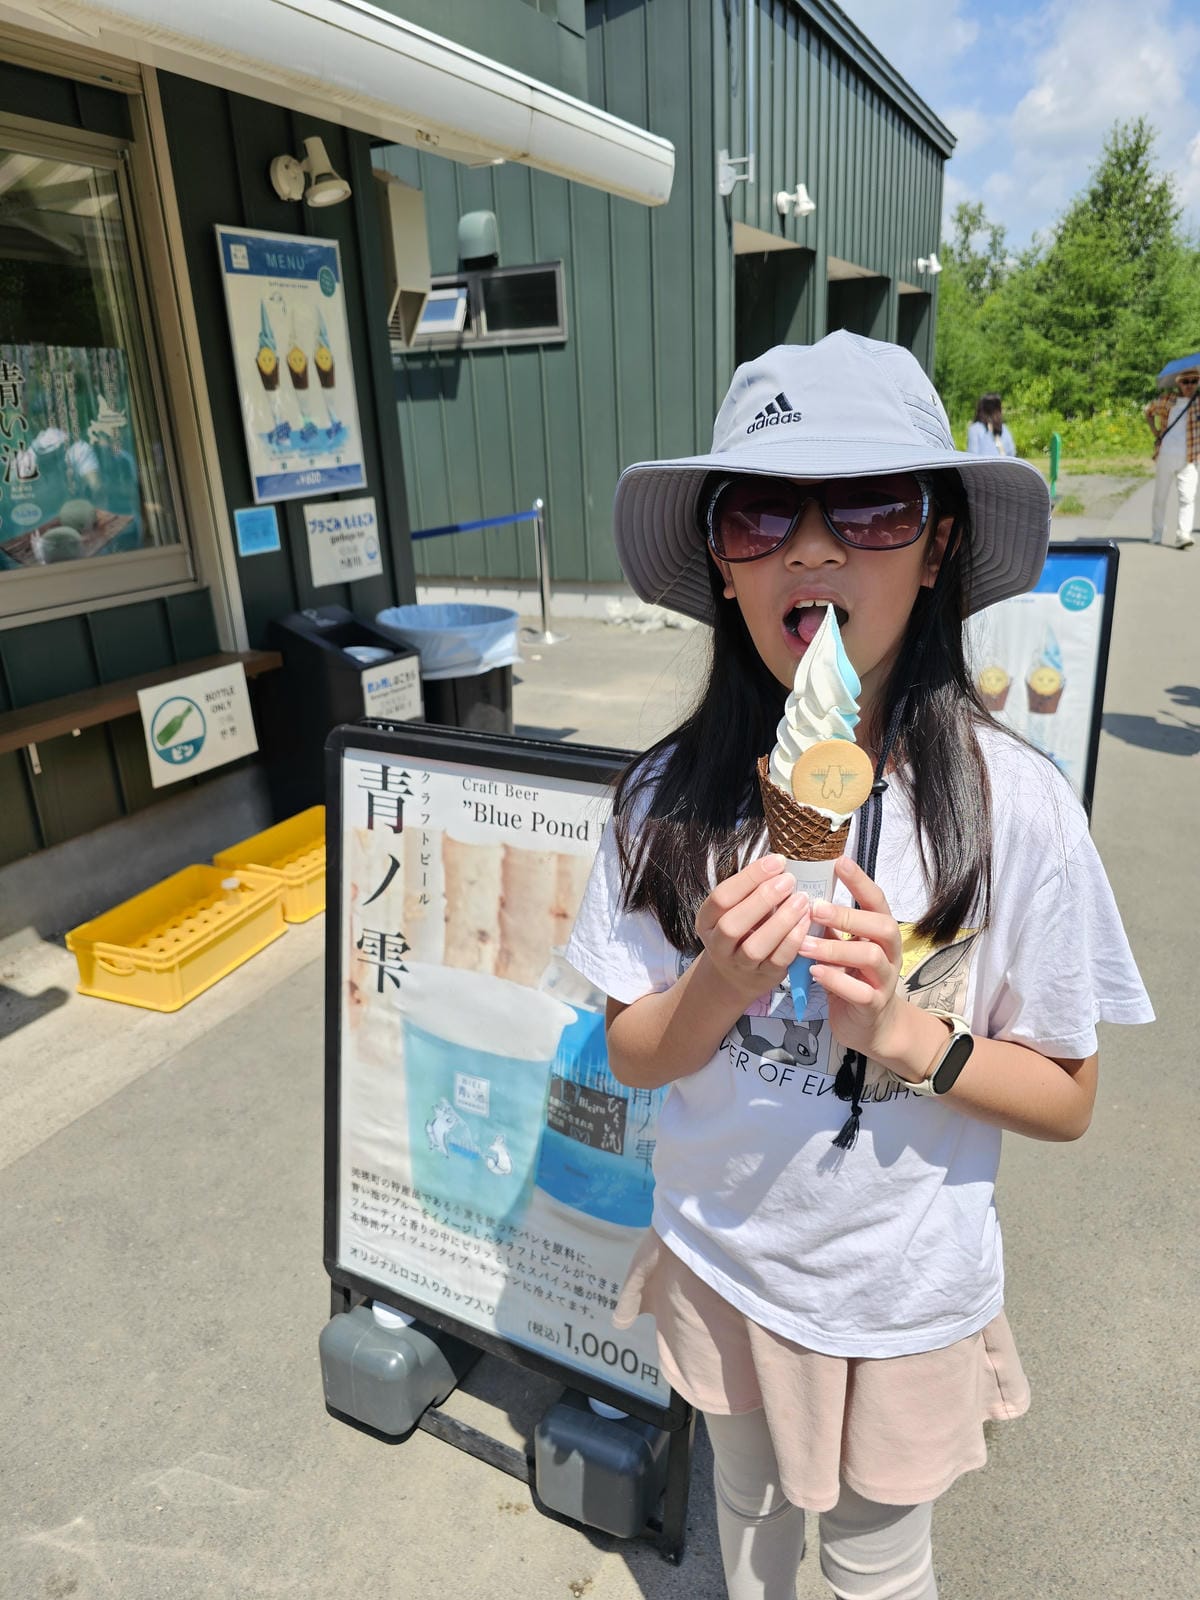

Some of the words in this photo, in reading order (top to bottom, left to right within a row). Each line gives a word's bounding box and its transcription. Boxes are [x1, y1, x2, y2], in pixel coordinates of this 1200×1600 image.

[265, 253, 305, 271] MENU
[746, 412, 802, 434] adidas
[206, 686, 235, 703] BOTTLE
[212, 700, 232, 714] ONLY
[462, 778, 499, 796] Craft
[505, 783, 540, 802] Beer
[419, 771, 433, 905] クラフトビール
[531, 811, 589, 842] Pond
[358, 764, 414, 993] 青ノ雫
[759, 1063, 795, 1087] OF
[350, 1247, 496, 1316] オリジナルロゴ入りカップ入り
[527, 1320, 560, 1344] (税込)
